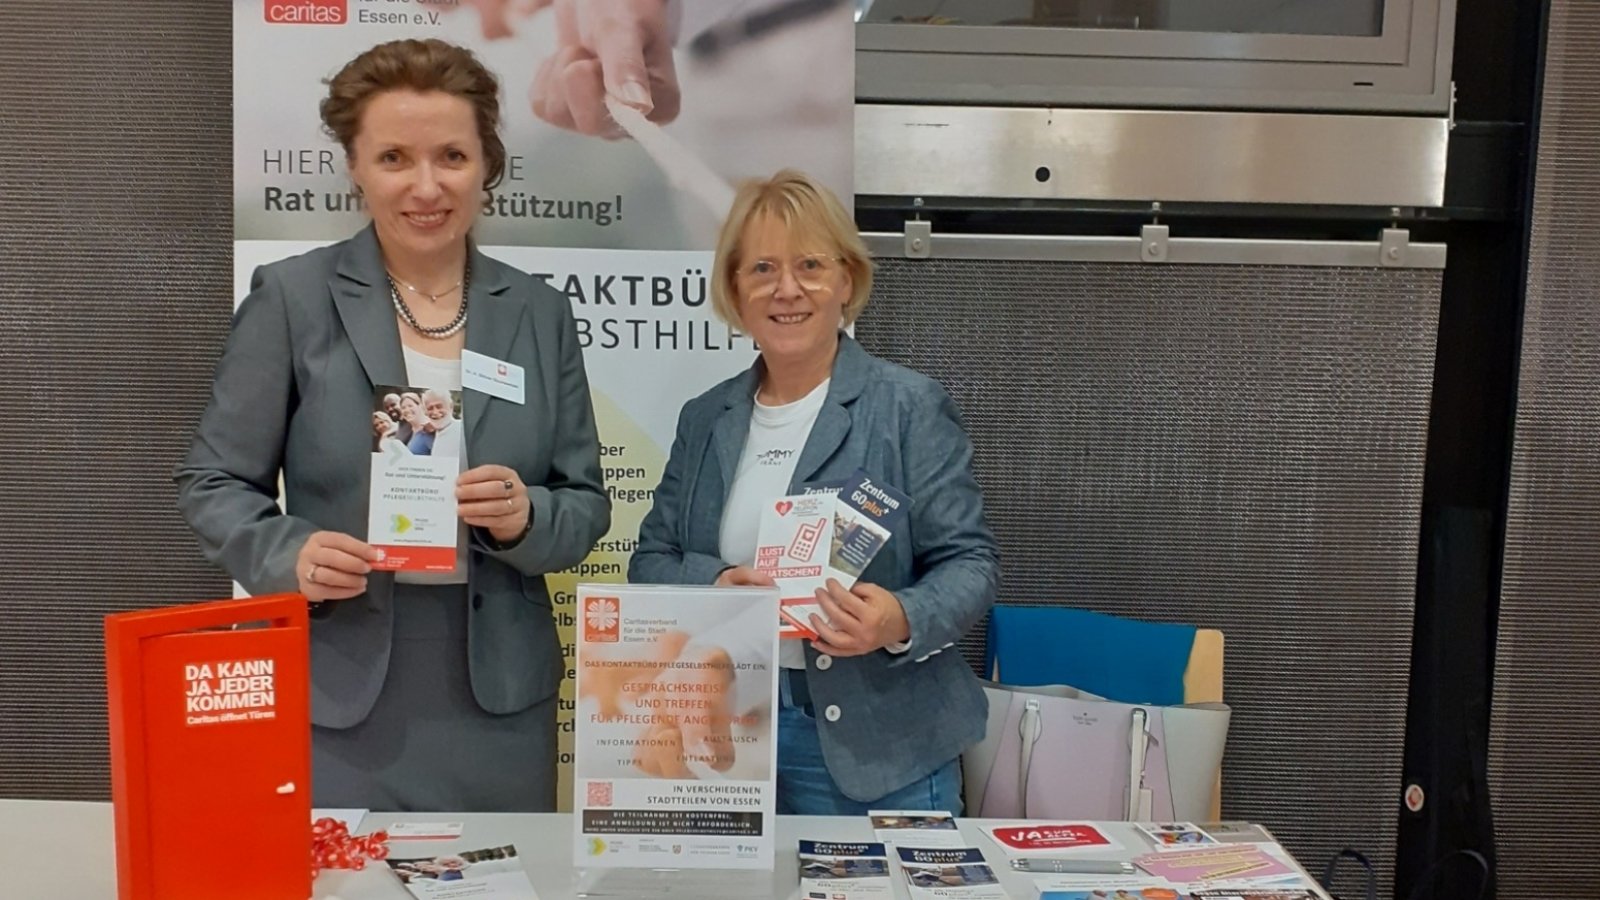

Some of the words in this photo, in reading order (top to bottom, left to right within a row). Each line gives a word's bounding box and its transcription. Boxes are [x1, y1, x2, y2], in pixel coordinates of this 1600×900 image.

[269, 4, 342, 23] caritas
[358, 9, 408, 24] Essen
[413, 11, 442, 26] e.V.
[263, 149, 335, 174] HIER
[264, 186, 315, 213] Rat
[601, 467, 646, 480] ppen
[859, 478, 900, 511] Zentrum
[759, 547, 784, 557] LUST
[757, 559, 778, 567] AUF
[602, 660, 658, 669] KONTAKTBÜRO
[185, 664, 214, 681] DA
[217, 659, 274, 679] KANN
[185, 680, 213, 697] JA
[214, 675, 274, 695] JEDER
[186, 691, 276, 713] KOMMEN
[635, 699, 661, 709] UND
[665, 699, 713, 709] TREFFEN
[590, 713, 613, 724] FÜR
[616, 714, 680, 725] PFLEGENDE
[596, 739, 676, 747] INFORMATIONEN
[703, 736, 758, 744] AUSTAUSCH
[617, 759, 643, 767] TIPPS
[673, 785, 683, 793] IN
[686, 785, 761, 794] VERSCHIEDENEN
[647, 796, 707, 804] STADTTEILEN
[709, 797, 730, 805] VON
[733, 797, 761, 806] ESSEN
[1010, 831, 1042, 842] JA
[813, 842, 869, 851] Zentrum
[912, 850, 967, 859] Zentrum
